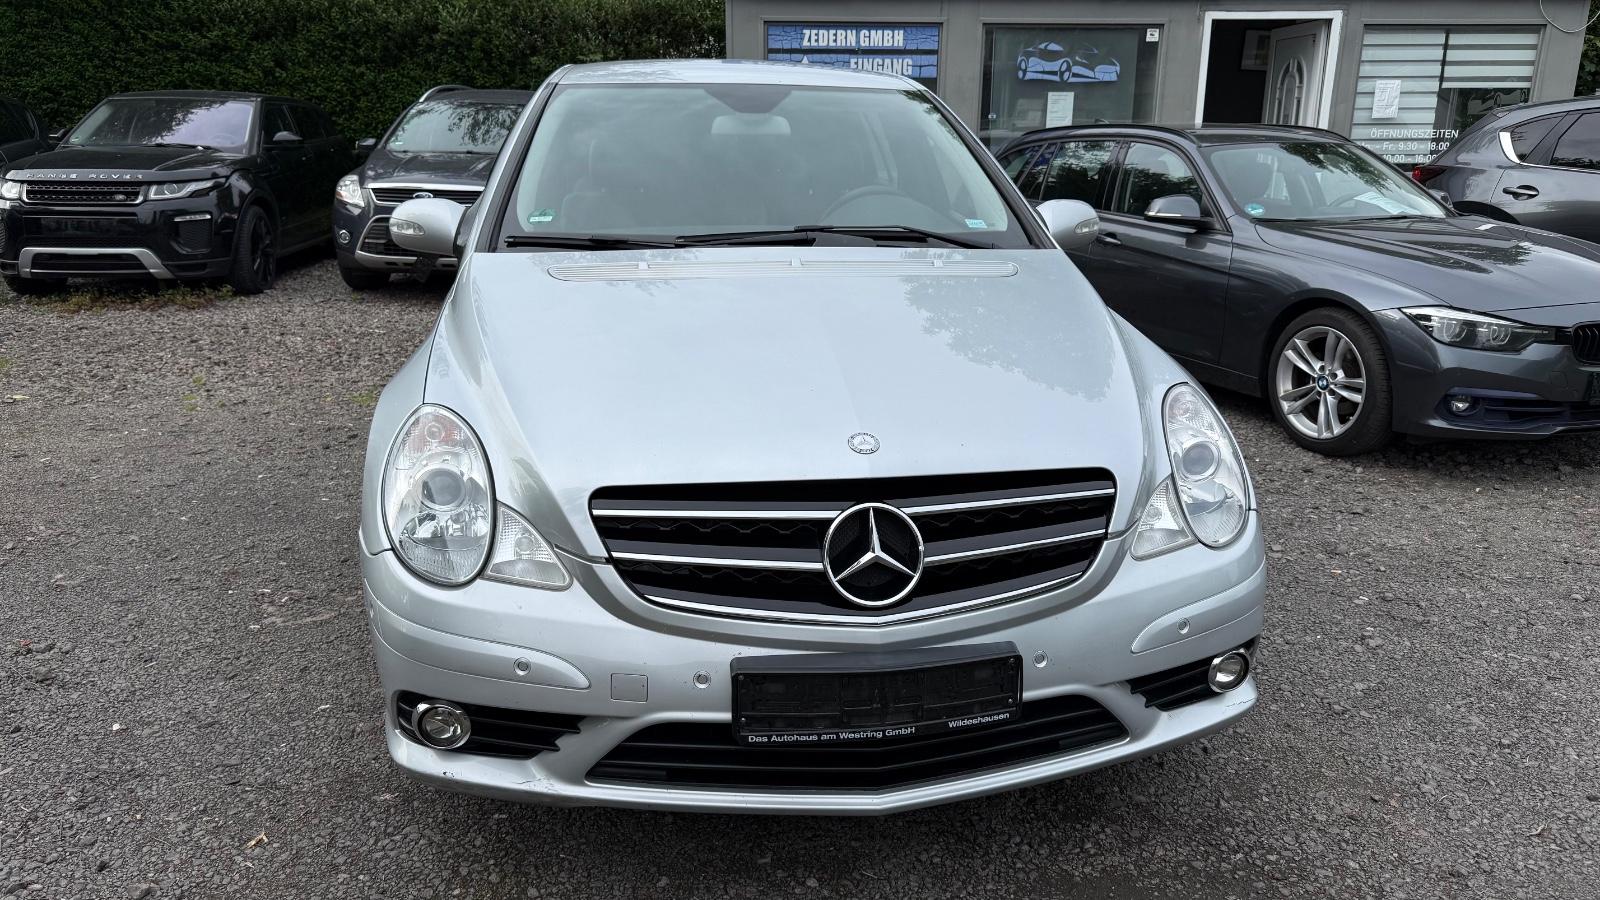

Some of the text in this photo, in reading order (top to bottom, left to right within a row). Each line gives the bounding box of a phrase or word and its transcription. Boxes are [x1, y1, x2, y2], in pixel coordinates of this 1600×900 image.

[802, 29, 904, 47] ZEDERN GMBH
[850, 58, 912, 75] EINGANG
[1370, 129, 1459, 139] ÖFFNUNGSZEITEN
[1382, 141, 1396, 151] Fr.
[1398, 141, 1417, 151] 9:30
[1427, 141, 1449, 151] 18:00
[948, 712, 1010, 728] Wildeshausen
[748, 727, 916, 743] Das Autohaus am Westring GmbH
